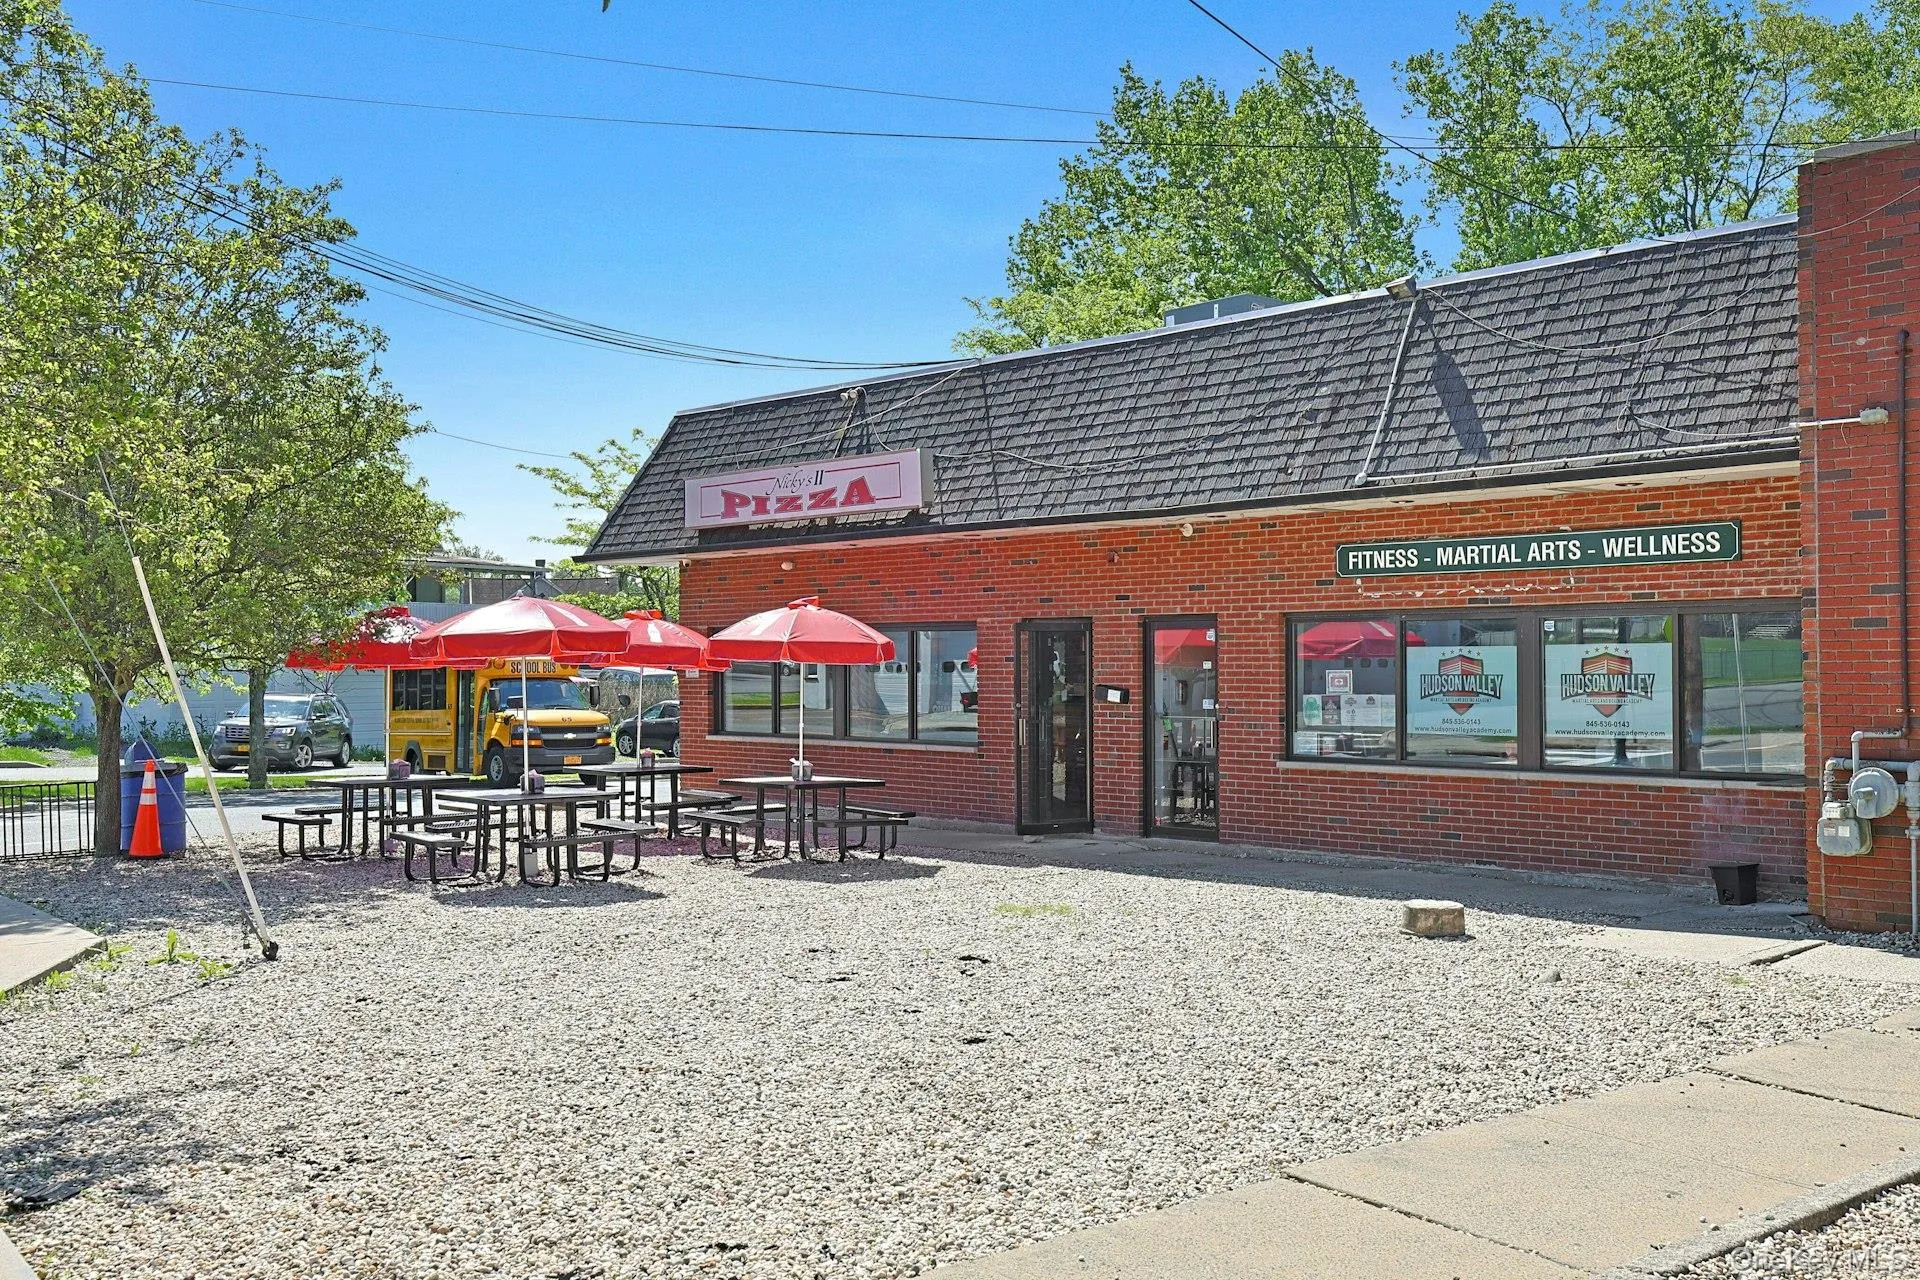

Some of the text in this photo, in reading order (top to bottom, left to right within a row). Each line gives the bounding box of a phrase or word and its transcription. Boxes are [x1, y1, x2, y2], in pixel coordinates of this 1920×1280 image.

[766, 469, 824, 495] Nicky's II
[721, 475, 876, 519] PIZZA
[1349, 549, 1419, 570] FITNESS
[1436, 543, 1521, 566] MARTIAL
[1527, 539, 1581, 562] ARTS
[1602, 531, 1721, 558] WELLNESS
[542, 661, 557, 673] BUS
[1422, 674, 1502, 697] HUDSON VALLEY
[1562, 673, 1654, 698] HUDSON VALLEY
[1414, 726, 1512, 734] www.hudsonvalleyacademy.com
[1554, 728, 1666, 737] www.hudsonvalleyacademy.com
[1585, 720, 1630, 728] 845-536-0143
